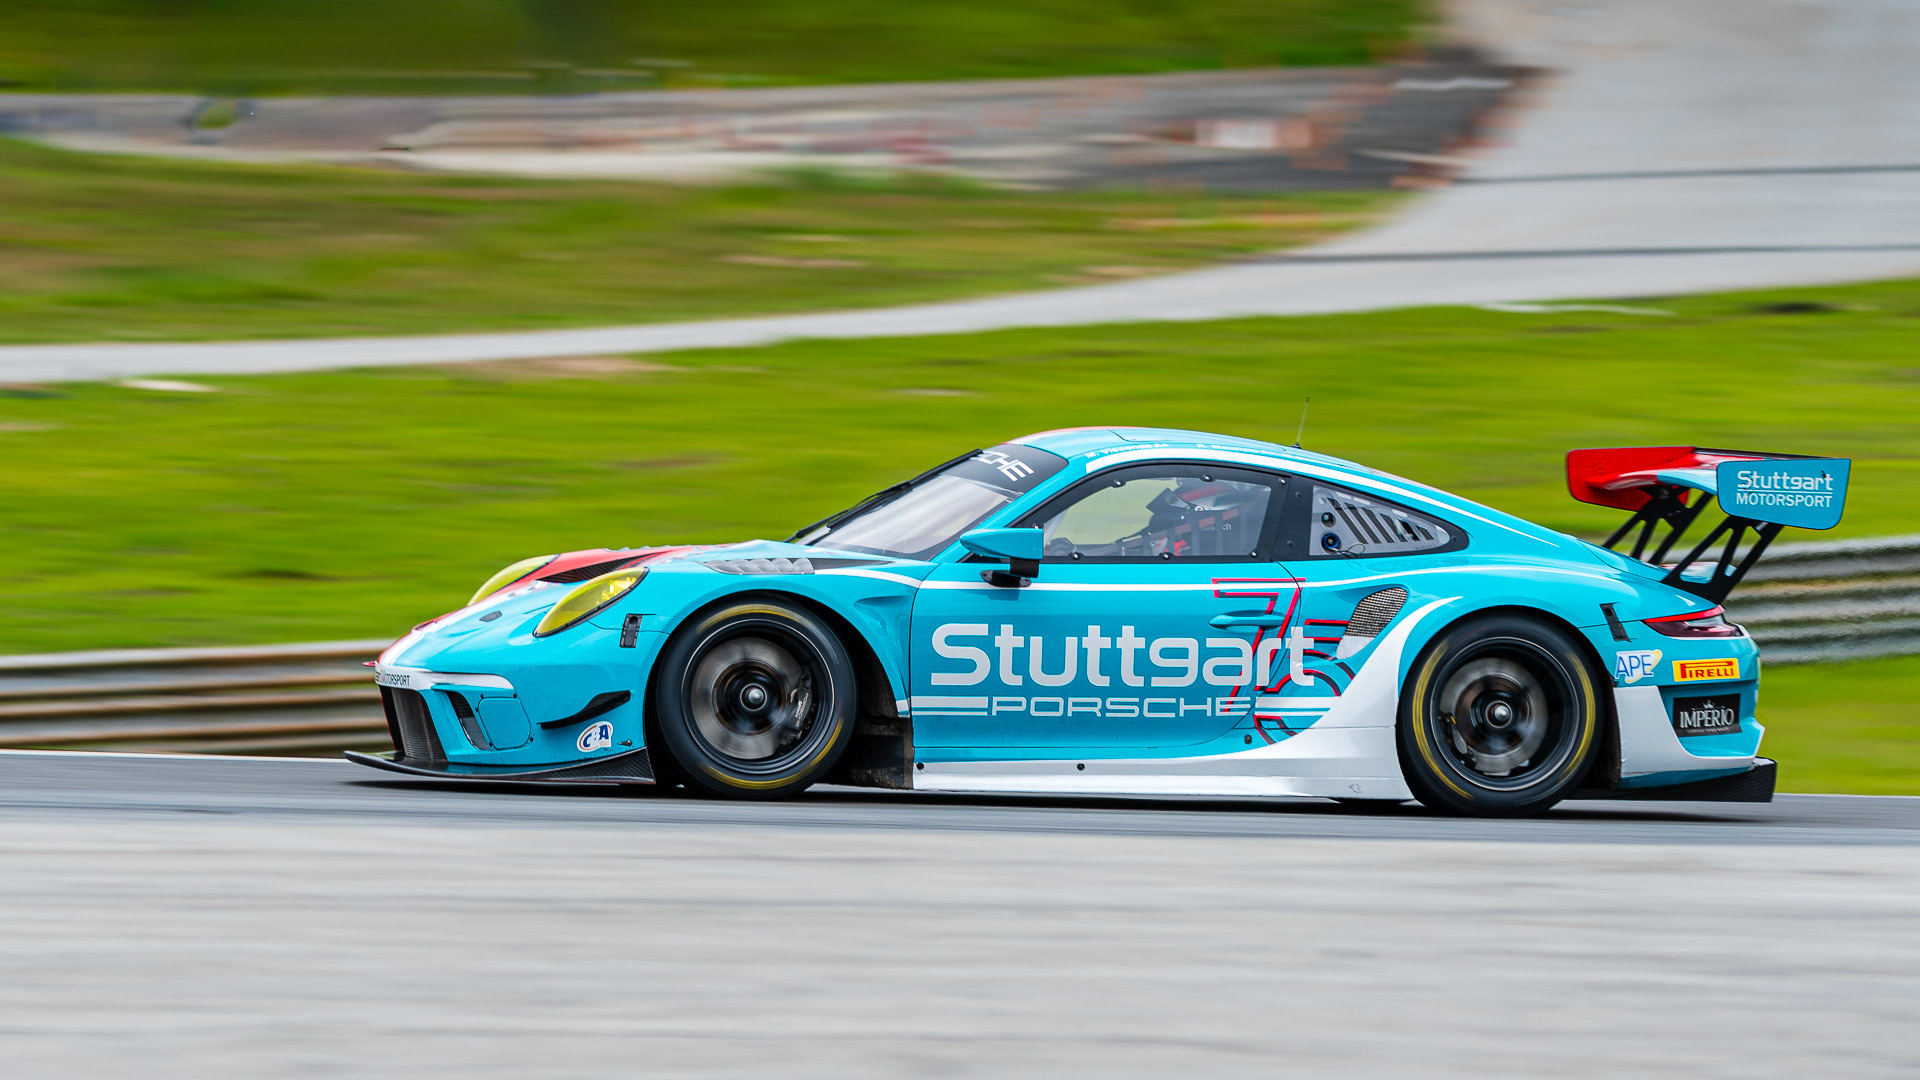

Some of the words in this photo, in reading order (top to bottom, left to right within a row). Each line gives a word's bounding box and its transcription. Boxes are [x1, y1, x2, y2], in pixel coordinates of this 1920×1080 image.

[1737, 470, 1834, 491] Stuttgart
[1736, 492, 1833, 508] MOTORSPORT
[930, 623, 1315, 688] Stuttgart
[1615, 654, 1654, 679] APE
[1679, 660, 1734, 679] PIRELLI
[992, 696, 1252, 718] PORSCHE
